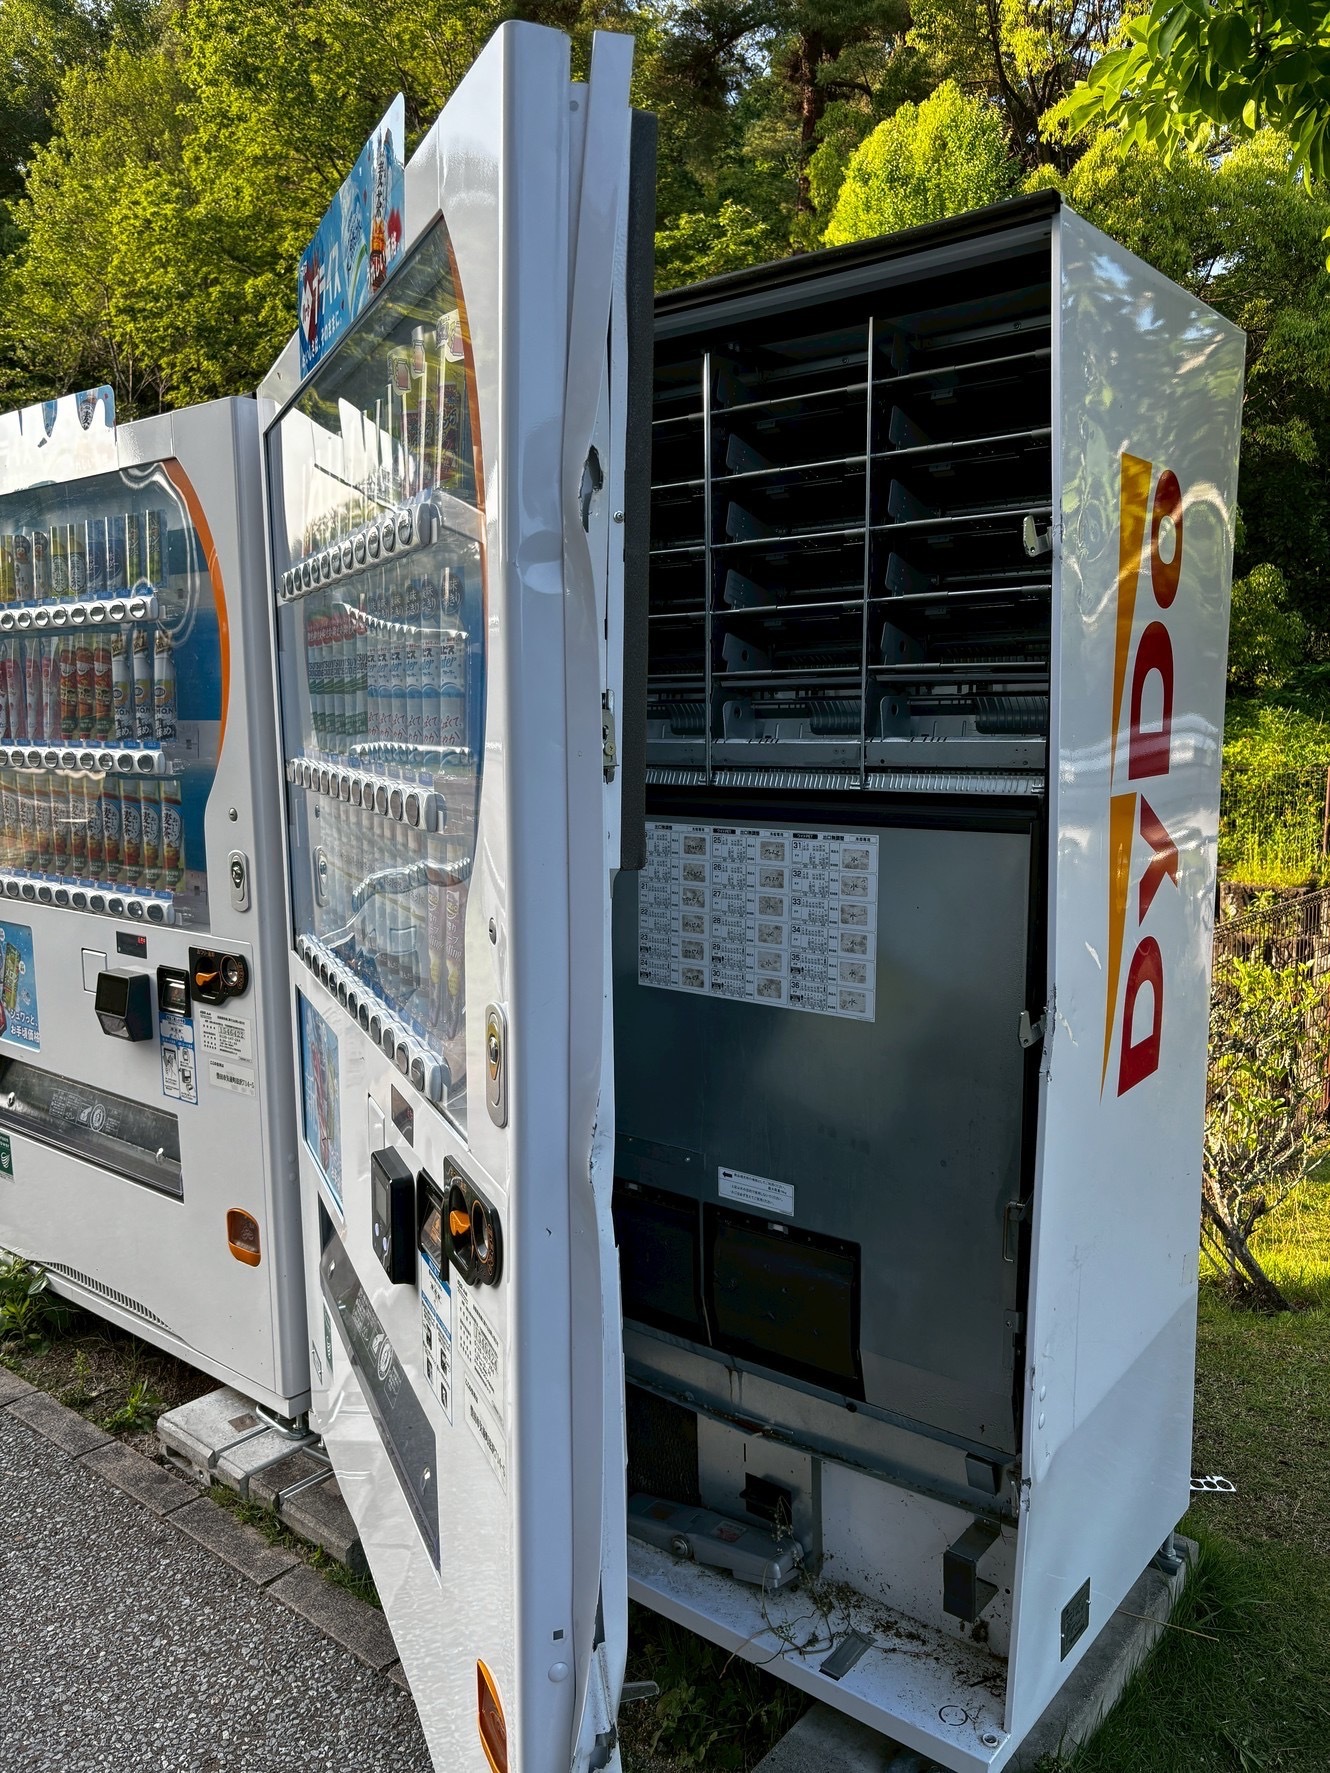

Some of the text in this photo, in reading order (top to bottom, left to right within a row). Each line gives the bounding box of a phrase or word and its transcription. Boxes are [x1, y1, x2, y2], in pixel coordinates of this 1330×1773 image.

[10, 1009, 38, 1026] シュワっと、
